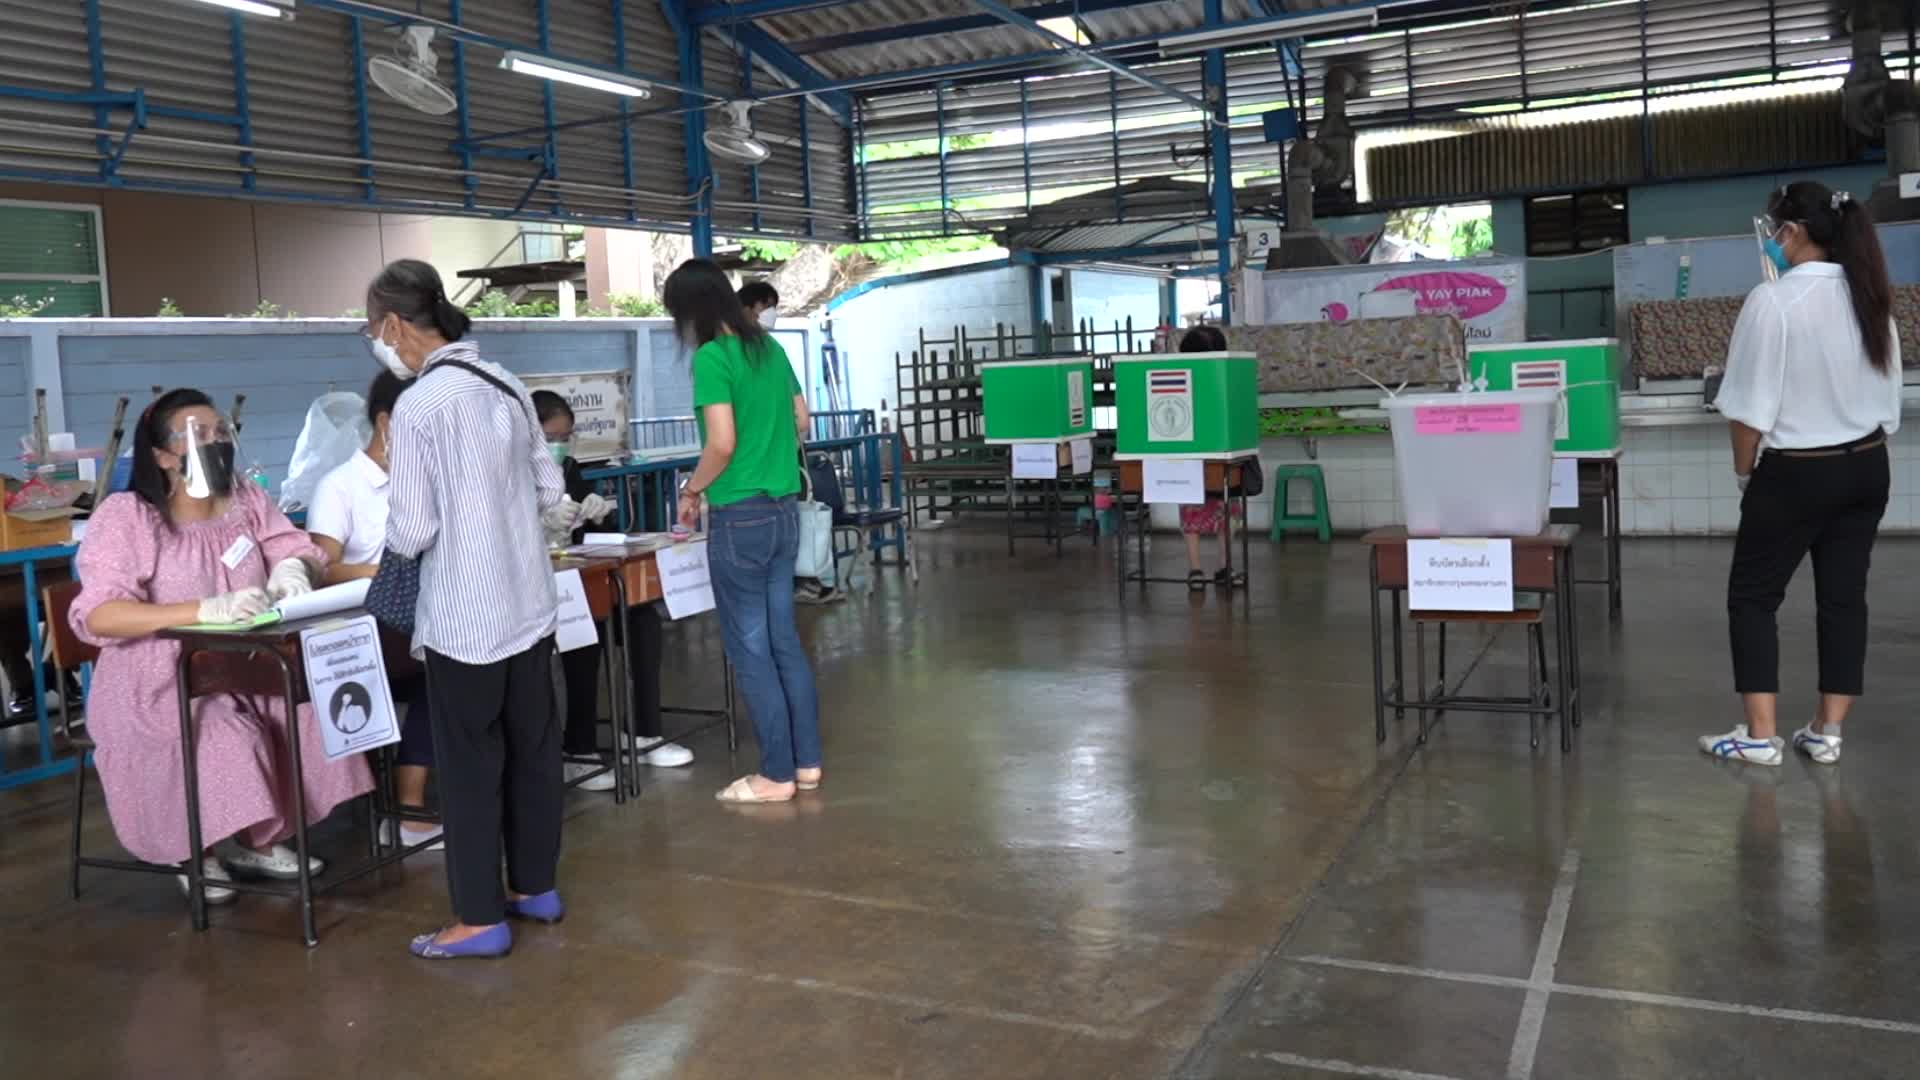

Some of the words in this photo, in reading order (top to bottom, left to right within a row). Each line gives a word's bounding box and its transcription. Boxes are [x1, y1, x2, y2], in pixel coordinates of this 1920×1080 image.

[1258, 232, 1269, 246] 3
[1426, 288, 1453, 301] YAY
[1455, 286, 1493, 298] PIAK
